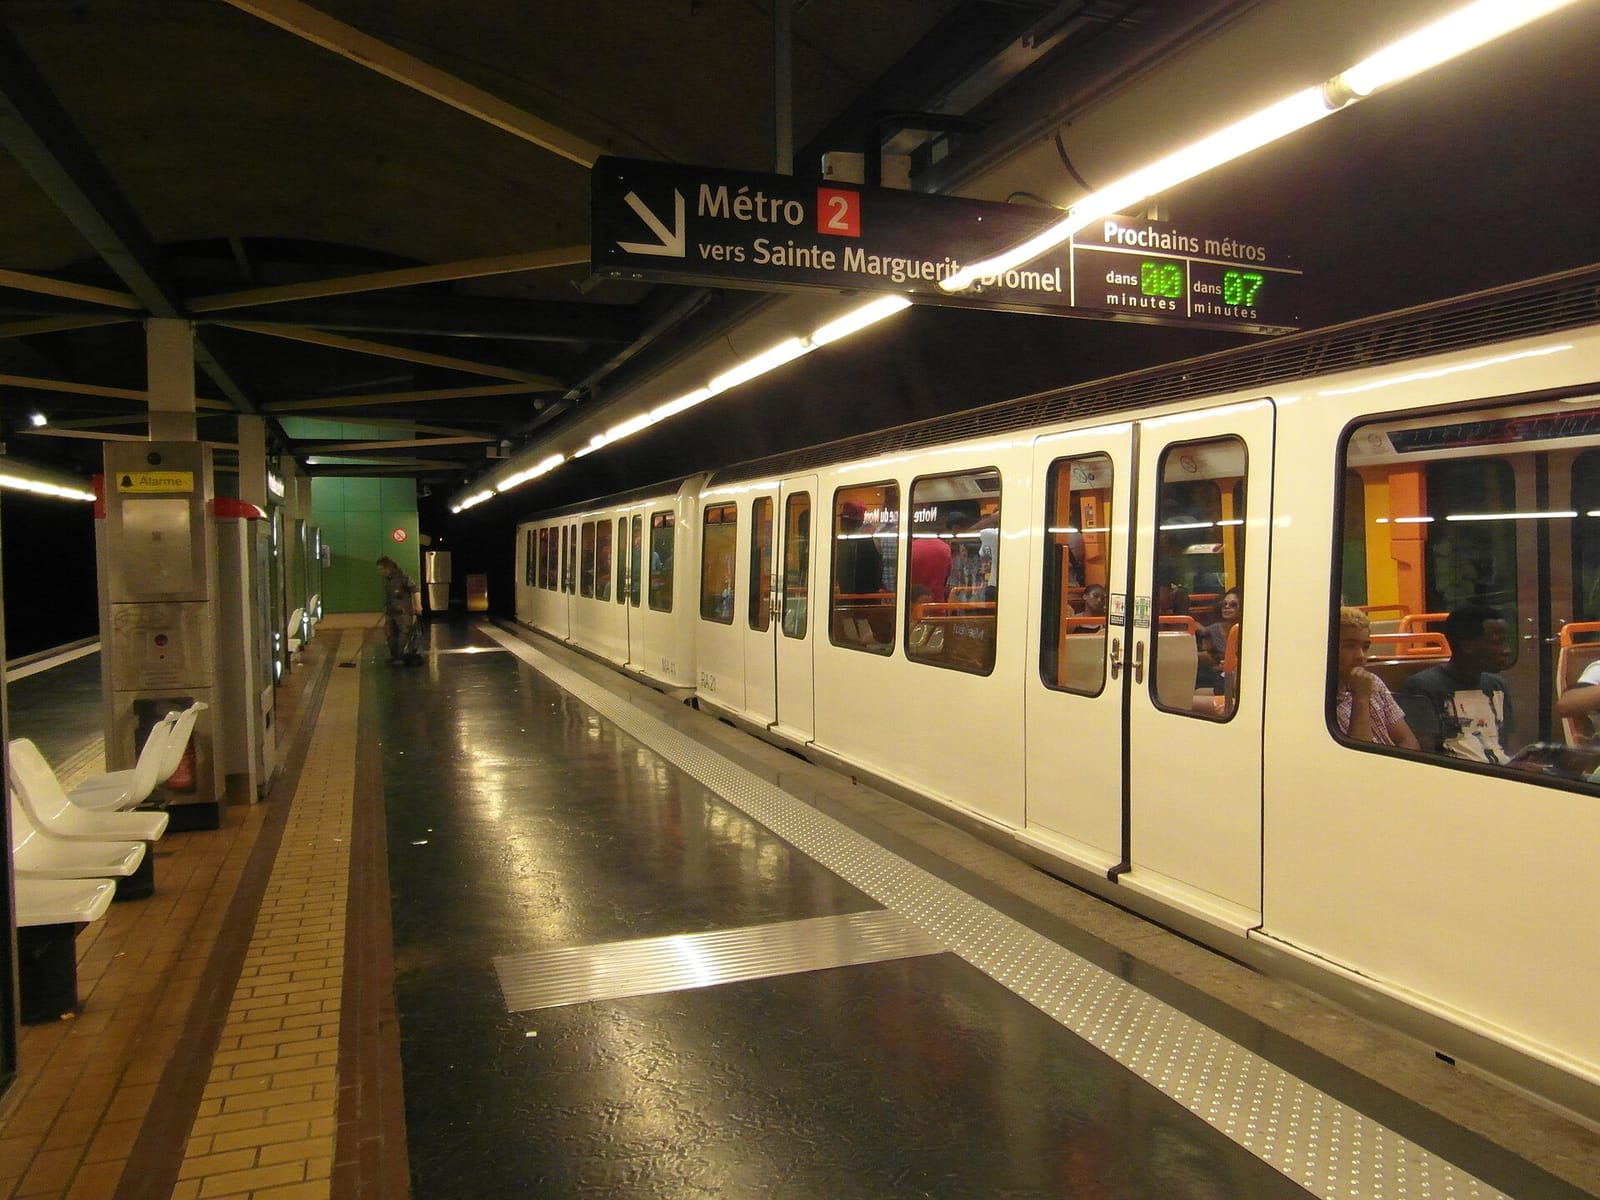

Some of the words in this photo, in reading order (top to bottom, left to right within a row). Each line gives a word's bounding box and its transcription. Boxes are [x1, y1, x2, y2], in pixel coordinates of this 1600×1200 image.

[698, 184, 804, 225] Métro
[828, 196, 849, 230] 2
[1104, 221, 1199, 253] Prochains
[1205, 237, 1266, 262] métros
[699, 243, 745, 262] vers
[753, 238, 835, 270] Sainte
[844, 247, 963, 283] Marguerit
[1106, 271, 1138, 286] dans
[1194, 281, 1221, 295] dans
[1224, 272, 1263, 307] 07
[1107, 293, 1176, 310] minutes
[1194, 302, 1257, 319] minutes
[140, 476, 182, 486] Alarme
